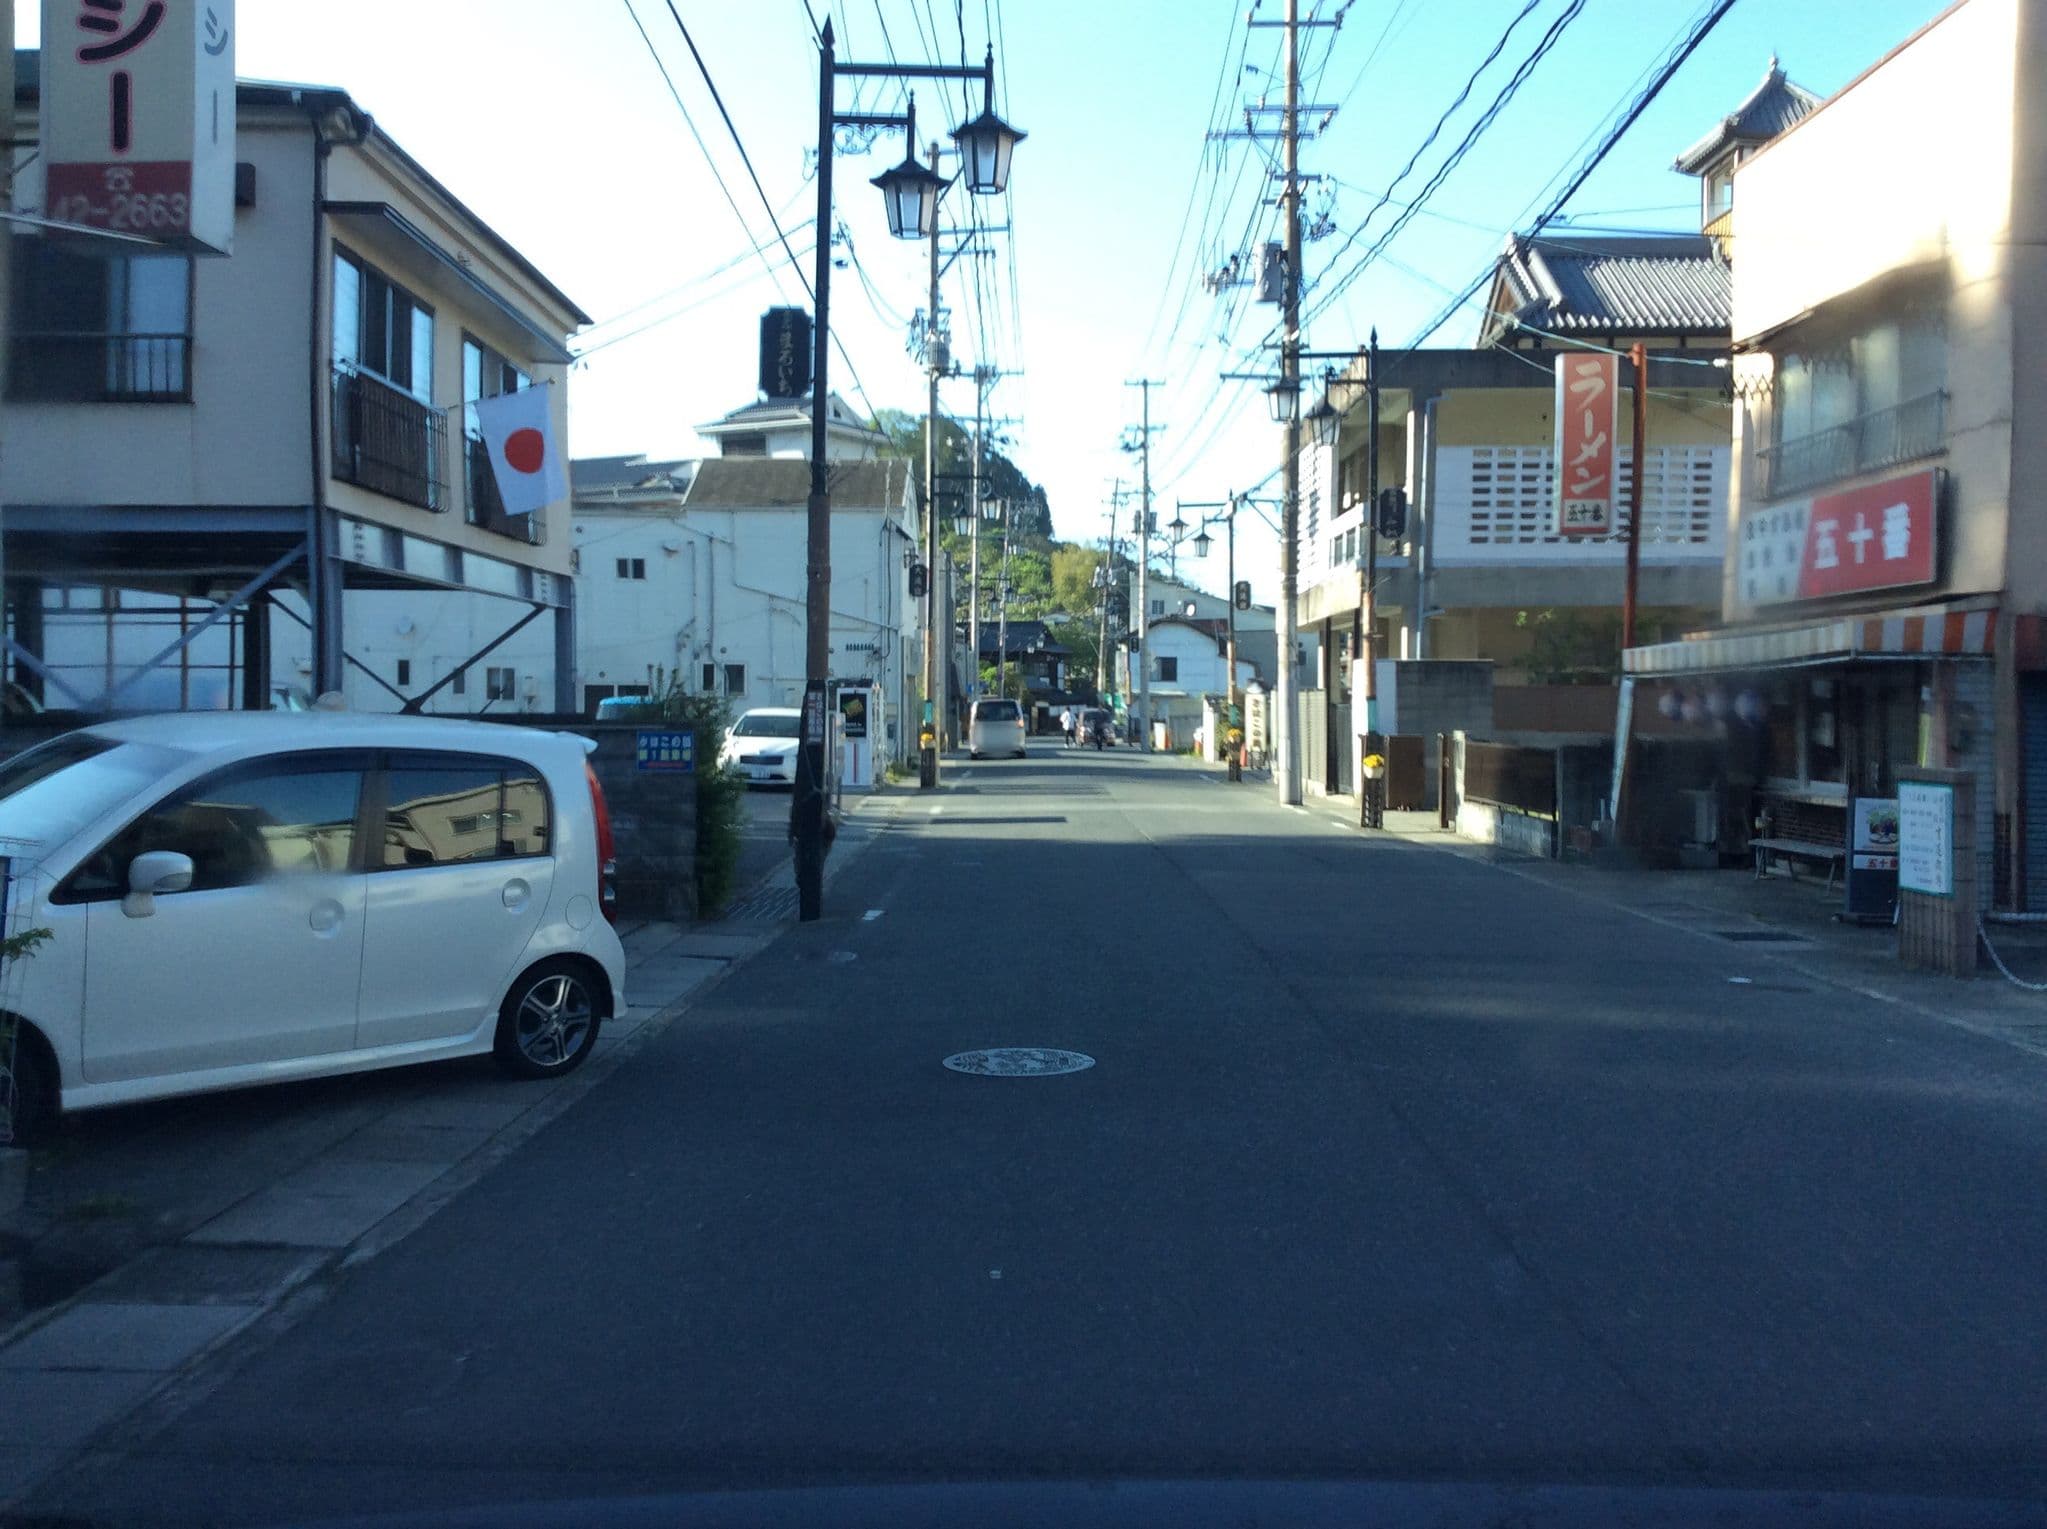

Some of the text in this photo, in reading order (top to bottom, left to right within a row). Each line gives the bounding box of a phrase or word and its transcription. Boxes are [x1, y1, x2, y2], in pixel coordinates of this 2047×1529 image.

[1569, 360, 1606, 495] ラーメン
[1814, 502, 1911, 569] 五十番
